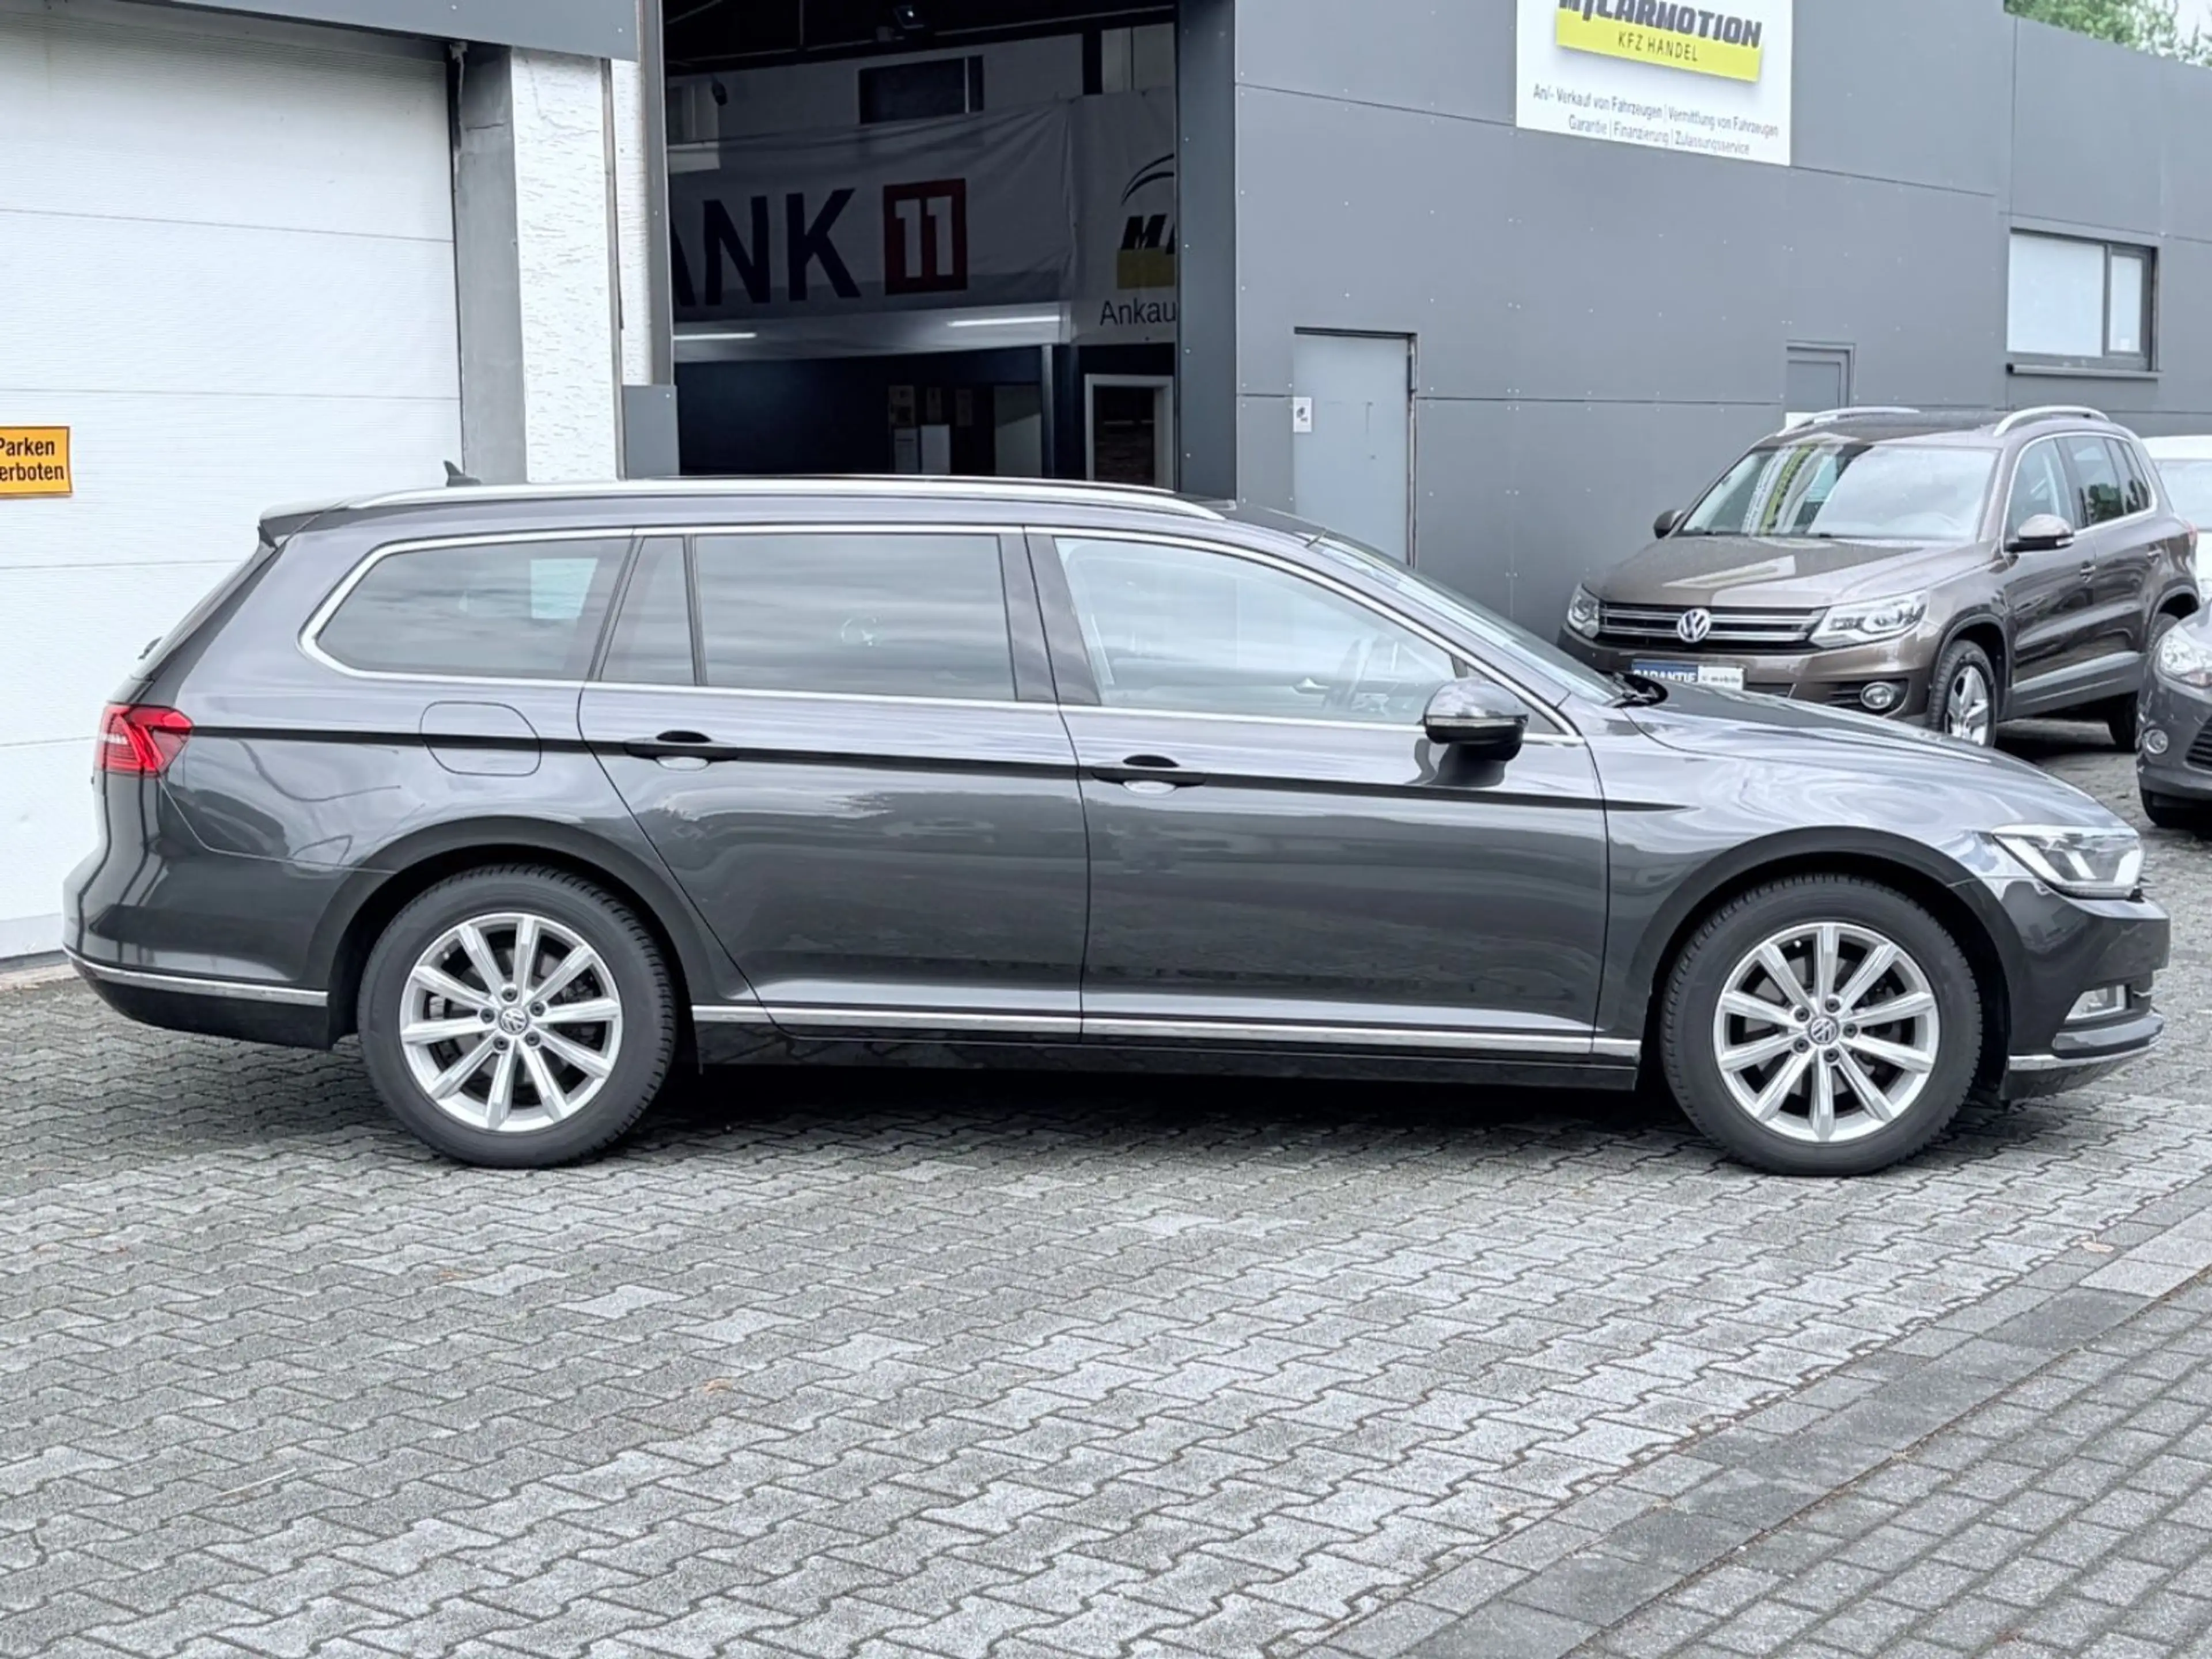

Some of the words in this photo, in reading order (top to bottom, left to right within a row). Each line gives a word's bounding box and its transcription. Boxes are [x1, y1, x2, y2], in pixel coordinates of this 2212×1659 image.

[1618, 31, 1643, 51] KFZ
[1647, 36, 1698, 62] HANDEL
[1556, 88, 1592, 108] Verkauf
[1593, 97, 1610, 110] von
[1612, 95, 1662, 120] Fahrzeugen
[1669, 105, 1715, 131] Vermittlung
[1717, 117, 1732, 130] von
[1733, 116, 1779, 139] Fahrzeugen
[1569, 113, 1608, 135] Garantie
[1614, 120, 1669, 146] Finanzierung
[1675, 130, 1750, 156] Zulassungsservice
[1100, 297, 1176, 326] Ankau
[0, 437, 55, 456] Parken
